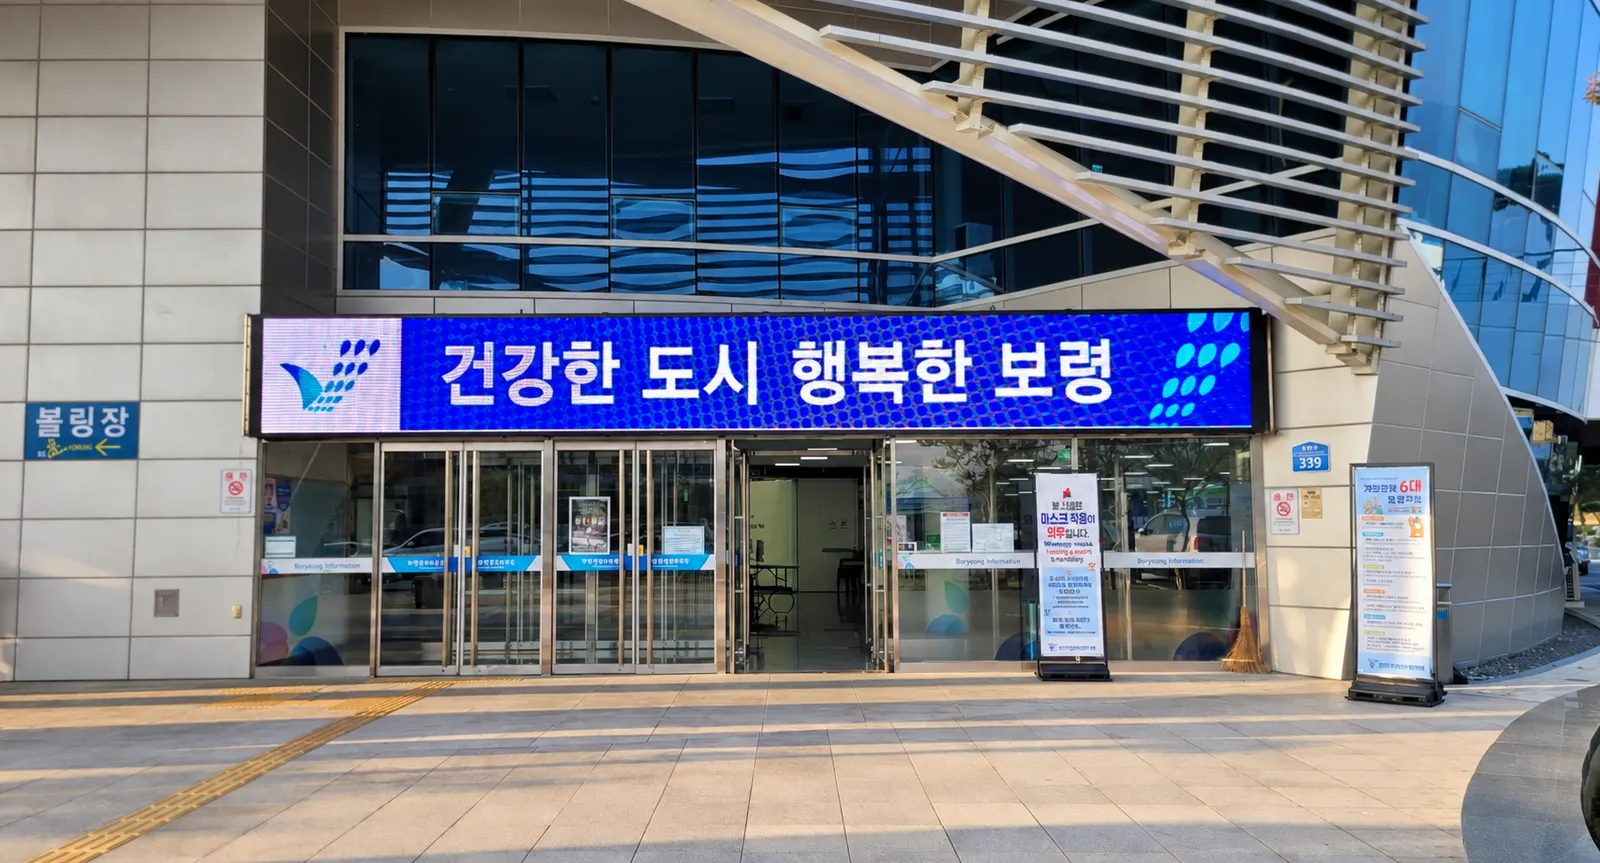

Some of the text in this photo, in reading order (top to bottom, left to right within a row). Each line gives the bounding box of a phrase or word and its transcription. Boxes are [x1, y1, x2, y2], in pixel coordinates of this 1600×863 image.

[442, 339, 1112, 406] 건강한 도시 행복한 보령
[36, 406, 129, 438] 볼링장
[1299, 456, 1322, 469] 339
[1400, 479, 1422, 493] 6대
[1041, 512, 1069, 525] 마스크
[1047, 526, 1090, 539] 의무입니다.
[324, 562, 361, 570] Information
[956, 557, 1021, 566] Boryeong Information
[1168, 557, 1204, 565] Information
